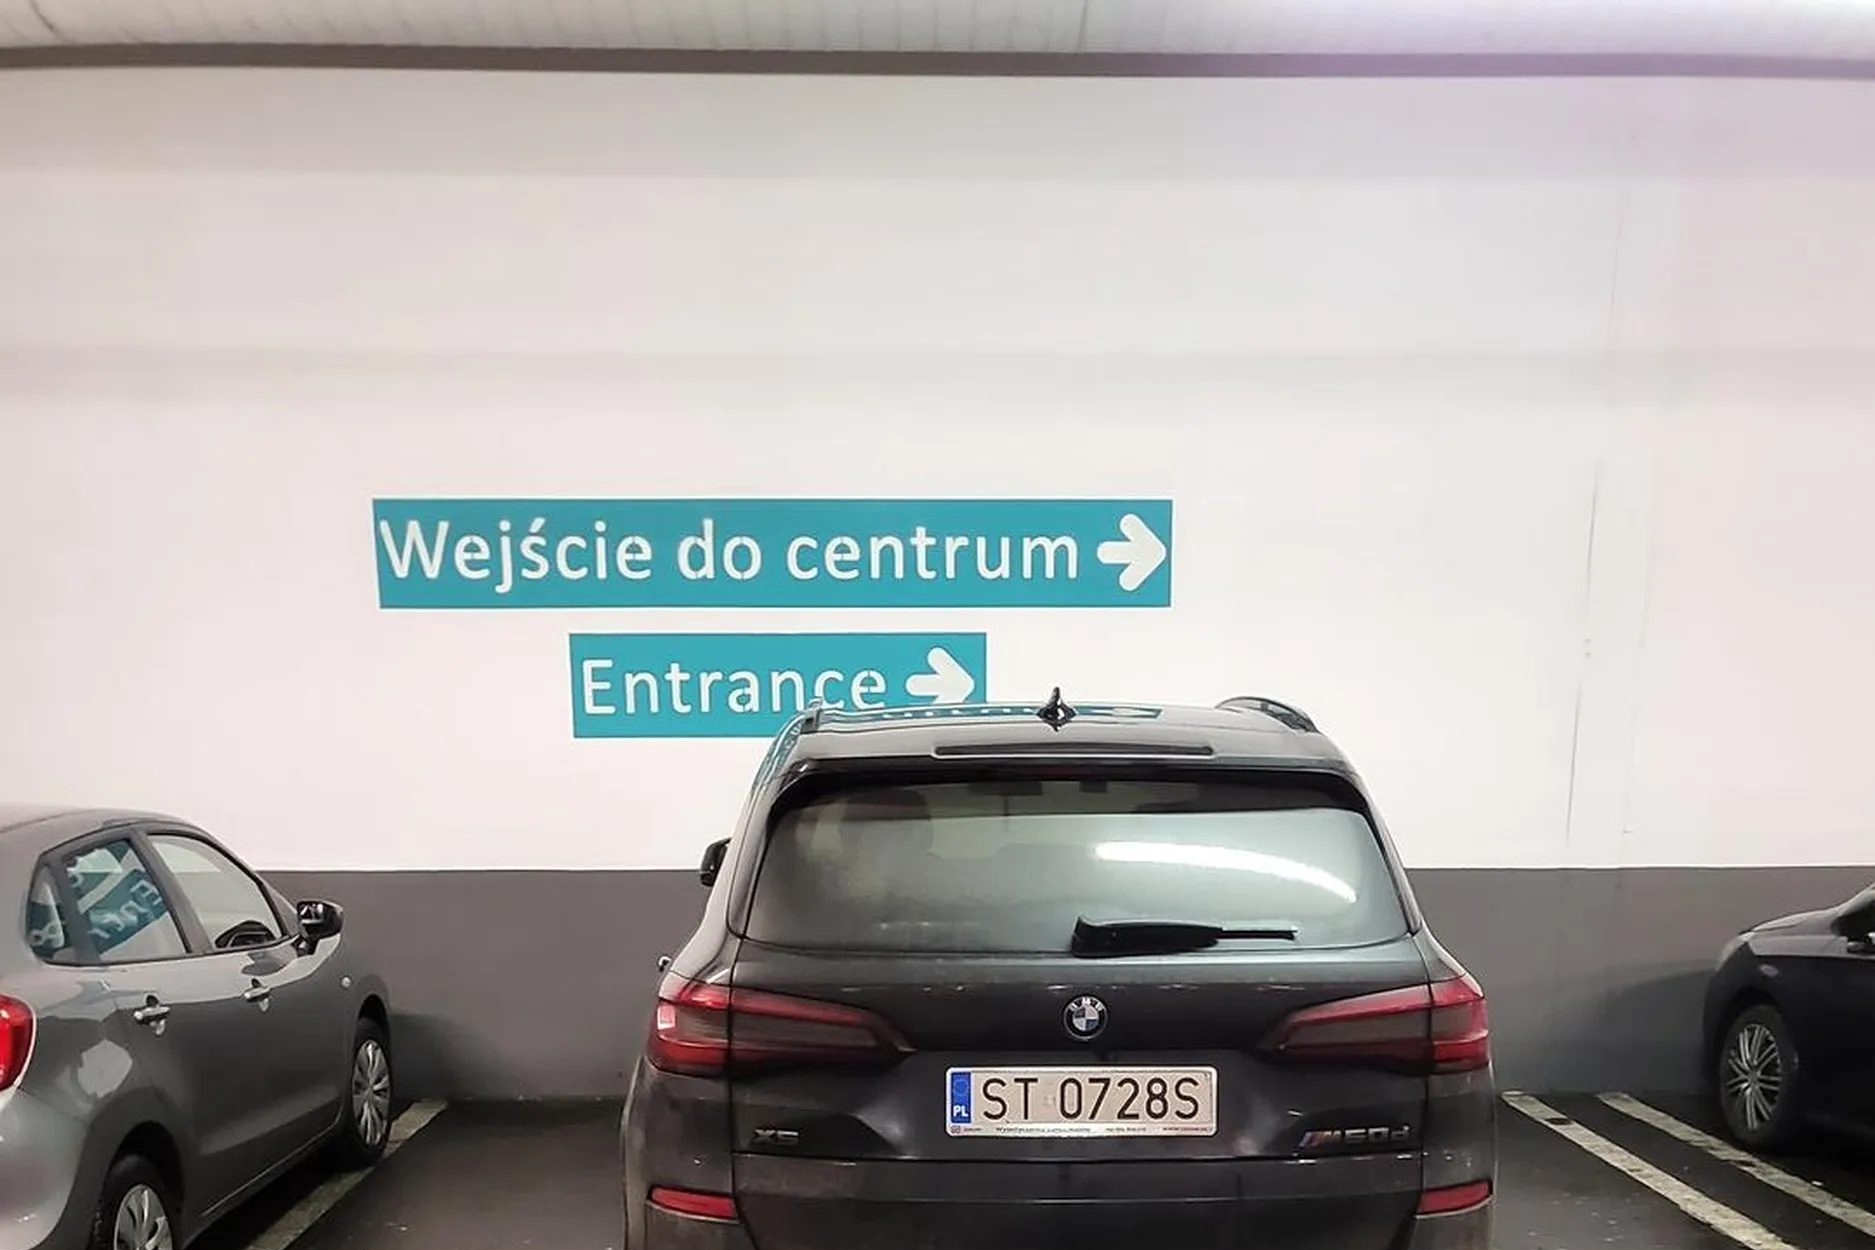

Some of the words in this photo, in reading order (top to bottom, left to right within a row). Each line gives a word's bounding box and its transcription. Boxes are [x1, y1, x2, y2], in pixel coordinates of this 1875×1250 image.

[378, 516, 654, 595] Wejście
[676, 517, 763, 581] do
[786, 526, 1080, 581] centrum
[581, 658, 887, 715] Entrance
[953, 1105, 969, 1117] PL
[982, 1077, 1038, 1120] ST
[1059, 1077, 1200, 1120] 0728S
